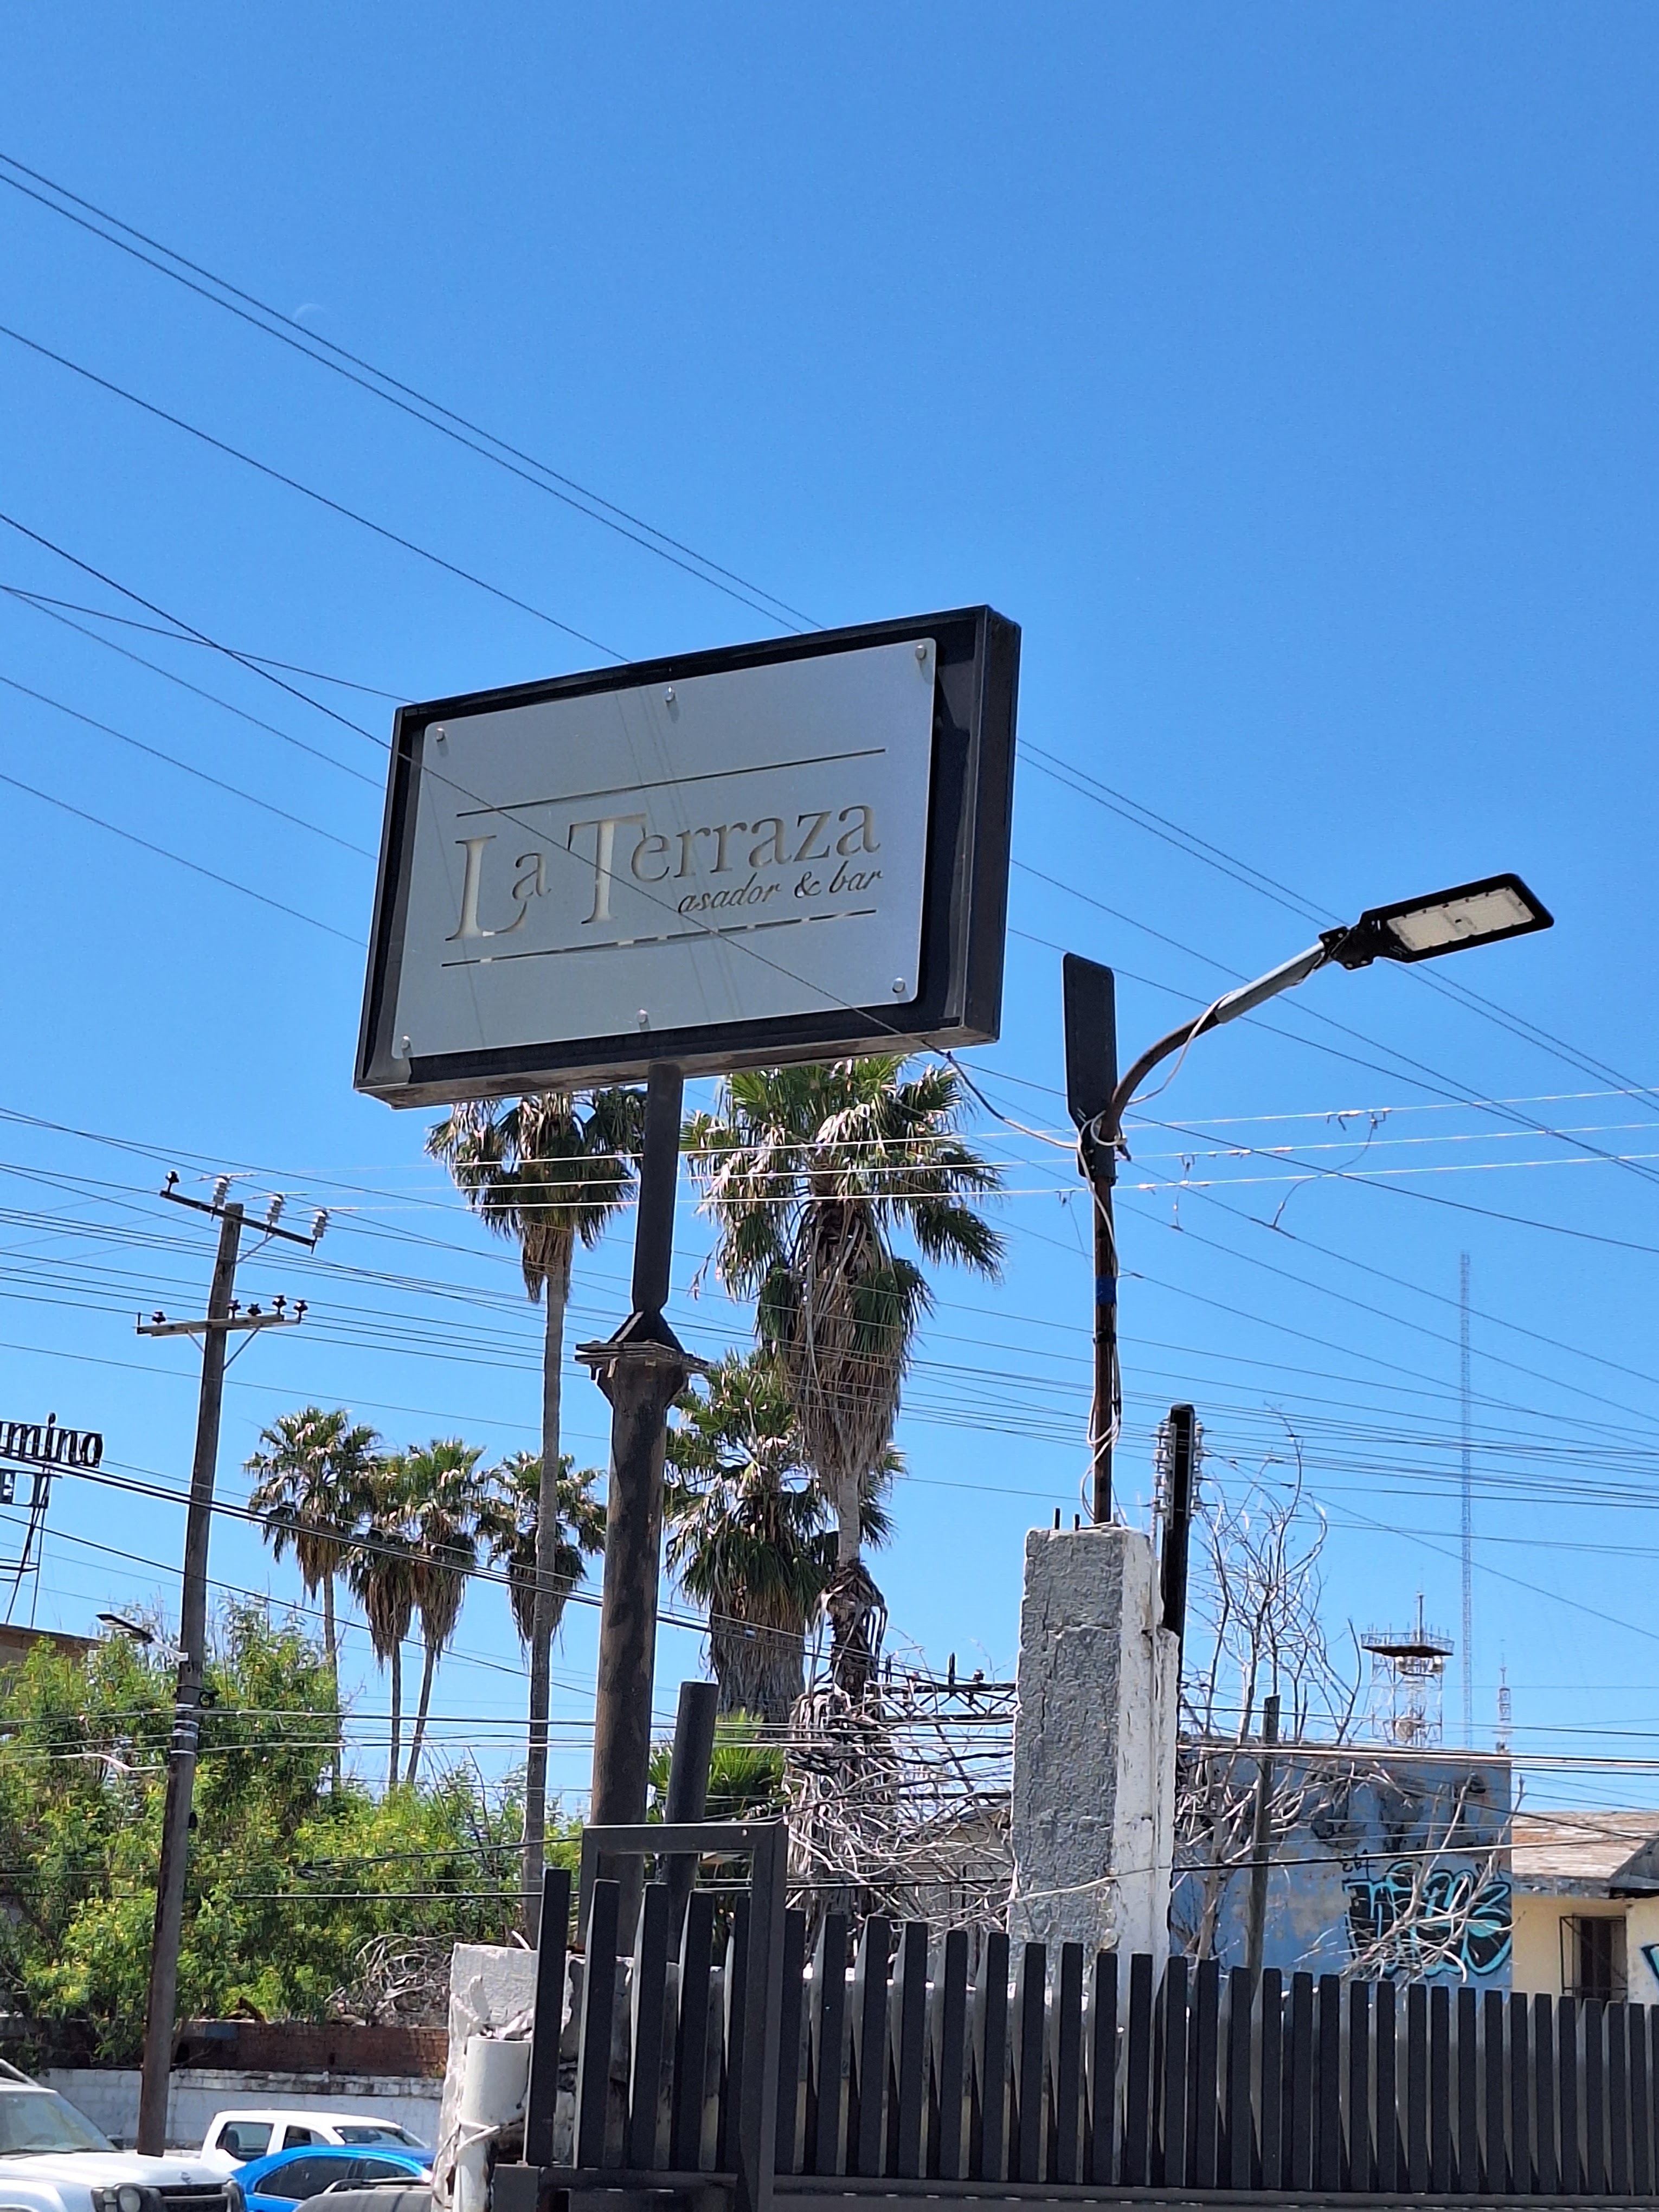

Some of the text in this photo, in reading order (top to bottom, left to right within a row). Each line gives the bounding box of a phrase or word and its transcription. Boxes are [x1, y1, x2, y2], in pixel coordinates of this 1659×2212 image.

[445, 804, 880, 941] La Terraza
[678, 860, 883, 913] asador & bar
[0, 1412, 103, 1468] mino
